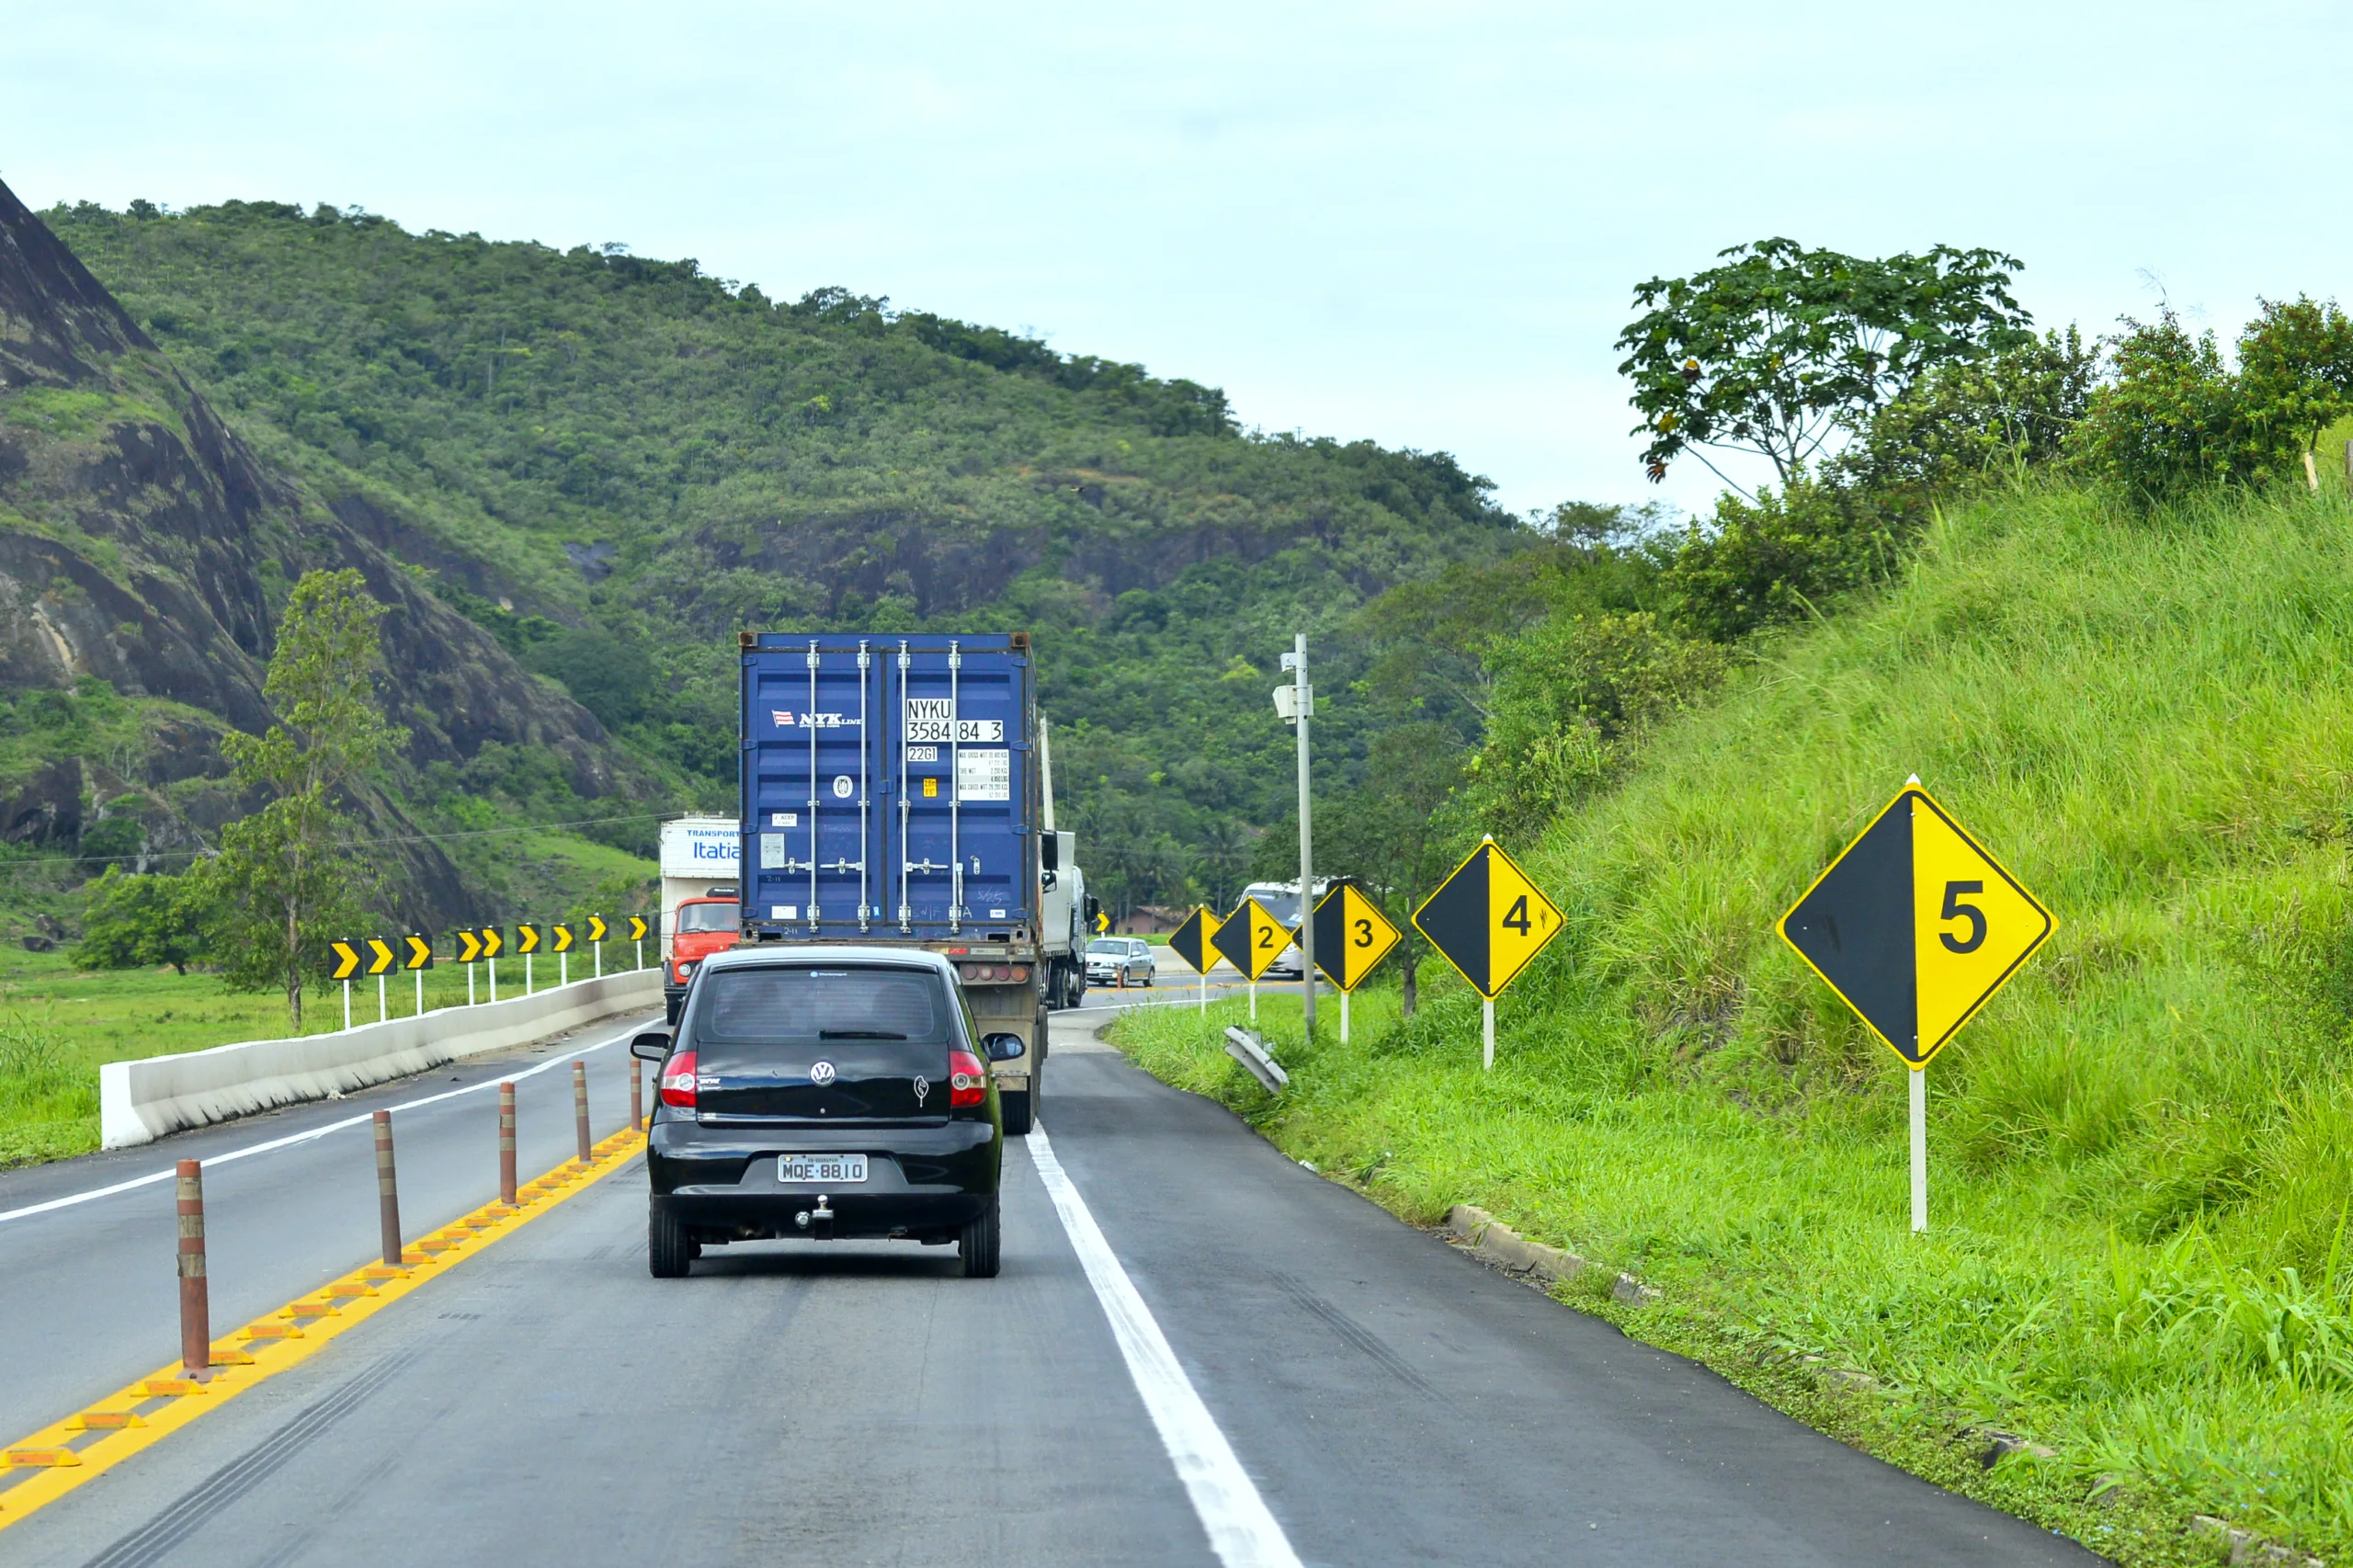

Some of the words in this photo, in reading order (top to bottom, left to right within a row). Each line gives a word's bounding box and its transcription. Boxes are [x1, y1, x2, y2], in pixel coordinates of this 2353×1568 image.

[800, 713, 843, 724] NYK
[908, 700, 950, 719] NYKU
[908, 722, 950, 740] 3584
[959, 722, 980, 740] 84
[992, 722, 1002, 740] 3
[687, 829, 739, 837] TRANSPORT
[694, 842, 739, 859] Itatia
[1502, 895, 1531, 937] 4
[1938, 880, 1987, 954] 5
[1258, 926, 1273, 949] 2
[1354, 919, 1373, 948] 3
